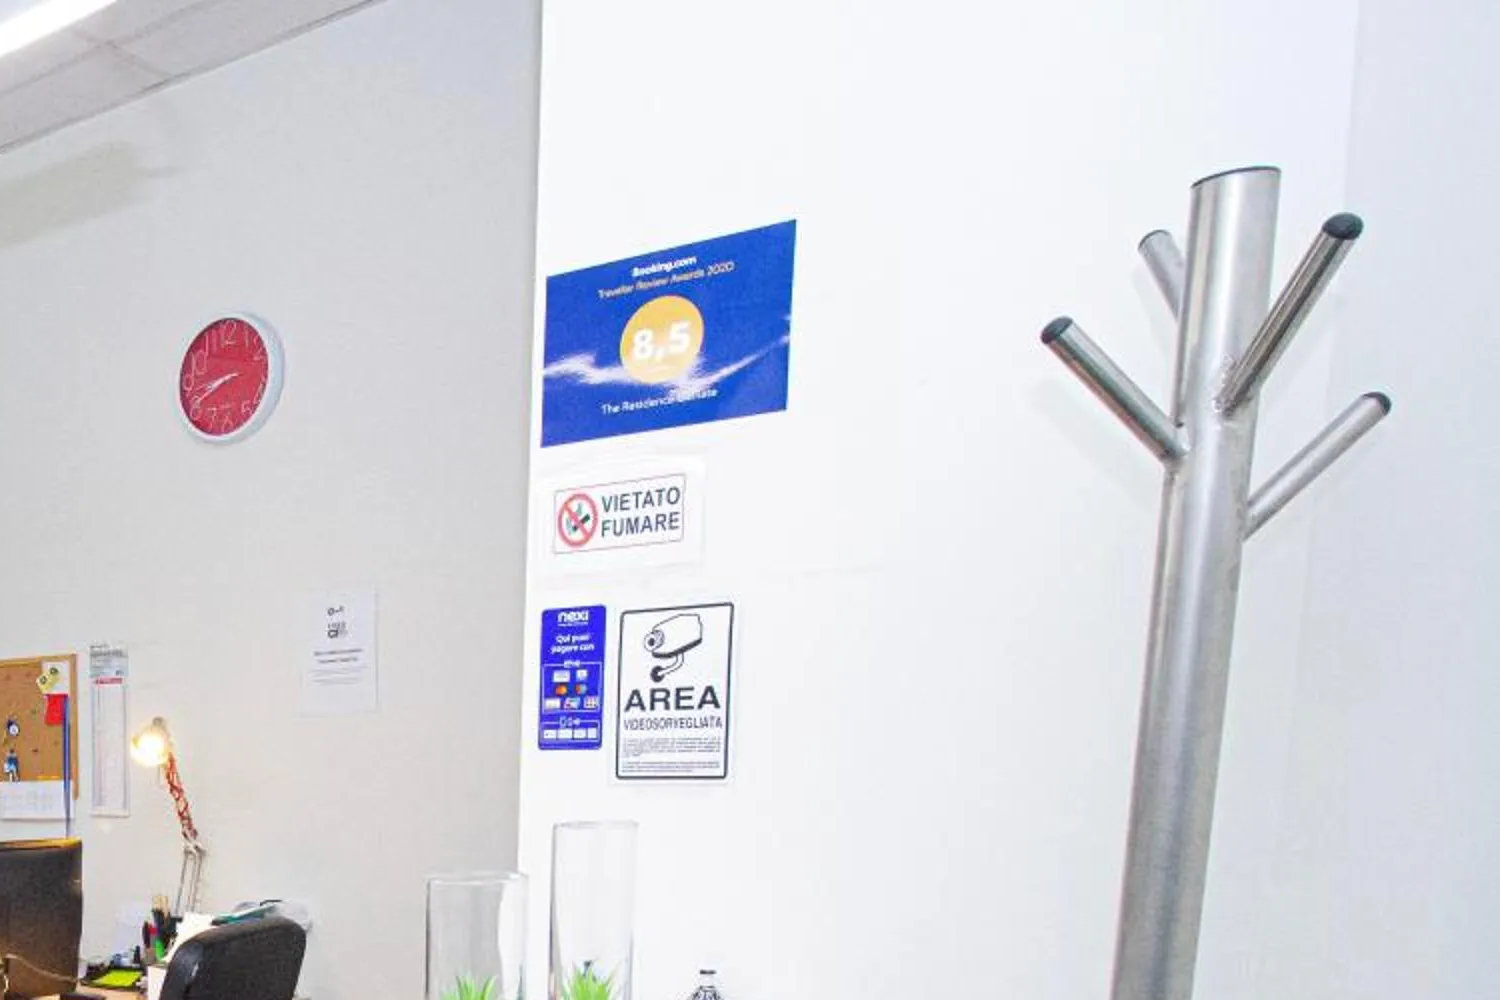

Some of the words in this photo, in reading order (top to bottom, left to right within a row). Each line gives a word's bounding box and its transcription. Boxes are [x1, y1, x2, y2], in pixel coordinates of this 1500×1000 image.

[632, 256, 697, 277] Booking.com
[631, 320, 692, 363] 8,5
[601, 402, 620, 415] The
[601, 486, 681, 513] VIETATO
[601, 511, 680, 538] FUMARE
[557, 611, 589, 622] nexi
[623, 685, 722, 713] AREA
[623, 715, 724, 732] VIDEOSORVEGLIATA
